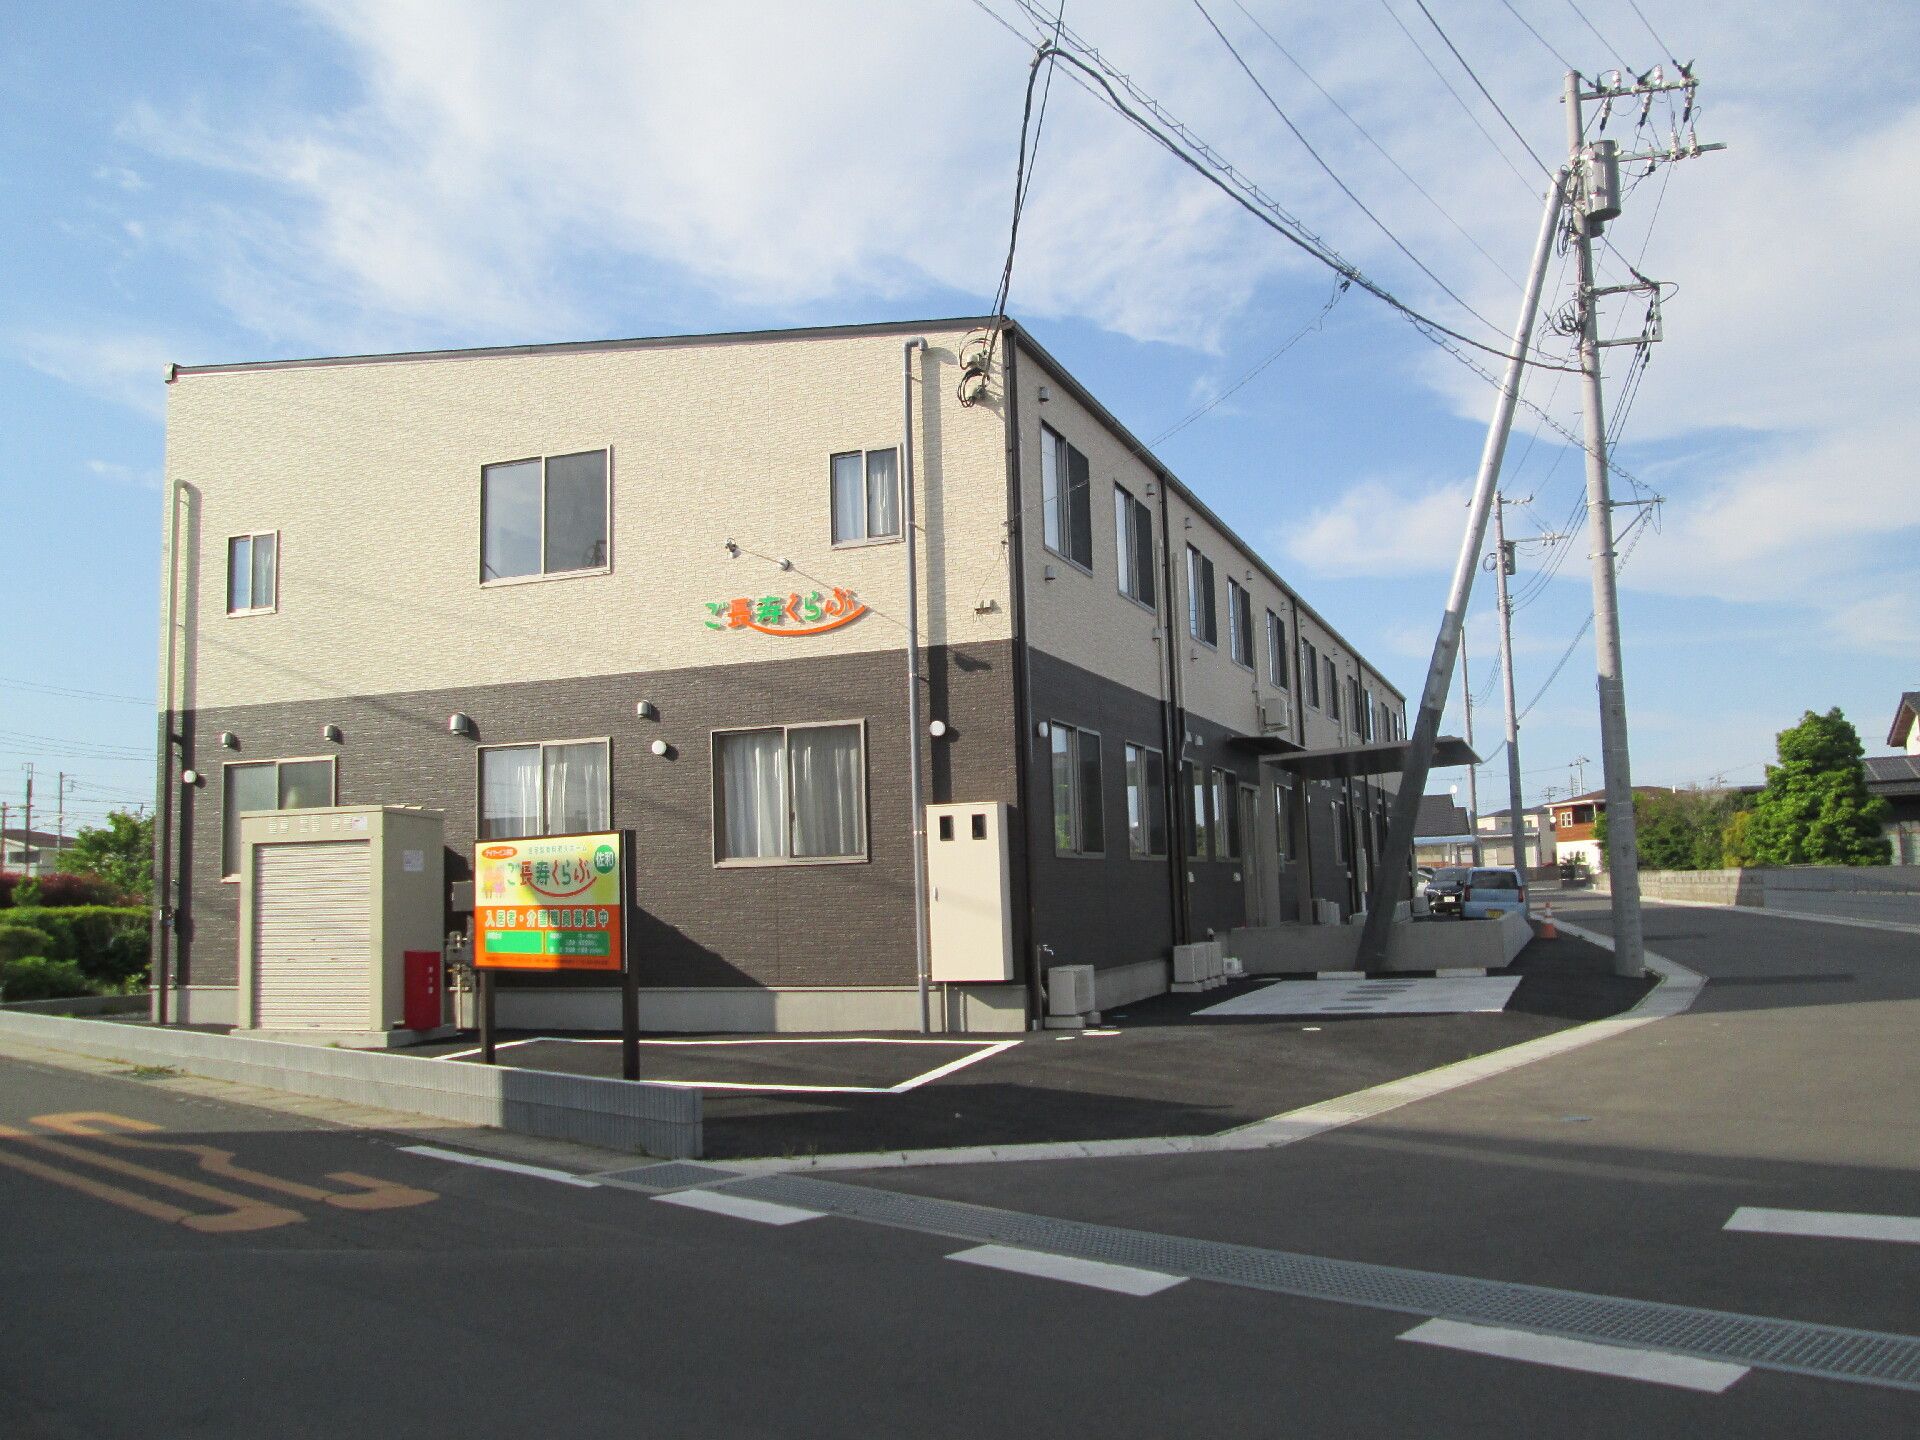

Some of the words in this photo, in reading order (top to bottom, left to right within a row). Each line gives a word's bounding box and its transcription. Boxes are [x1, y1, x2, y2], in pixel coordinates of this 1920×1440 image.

[704, 586, 858, 631] ご長寿くらぶ
[506, 857, 592, 887] ご長寿くらぶ
